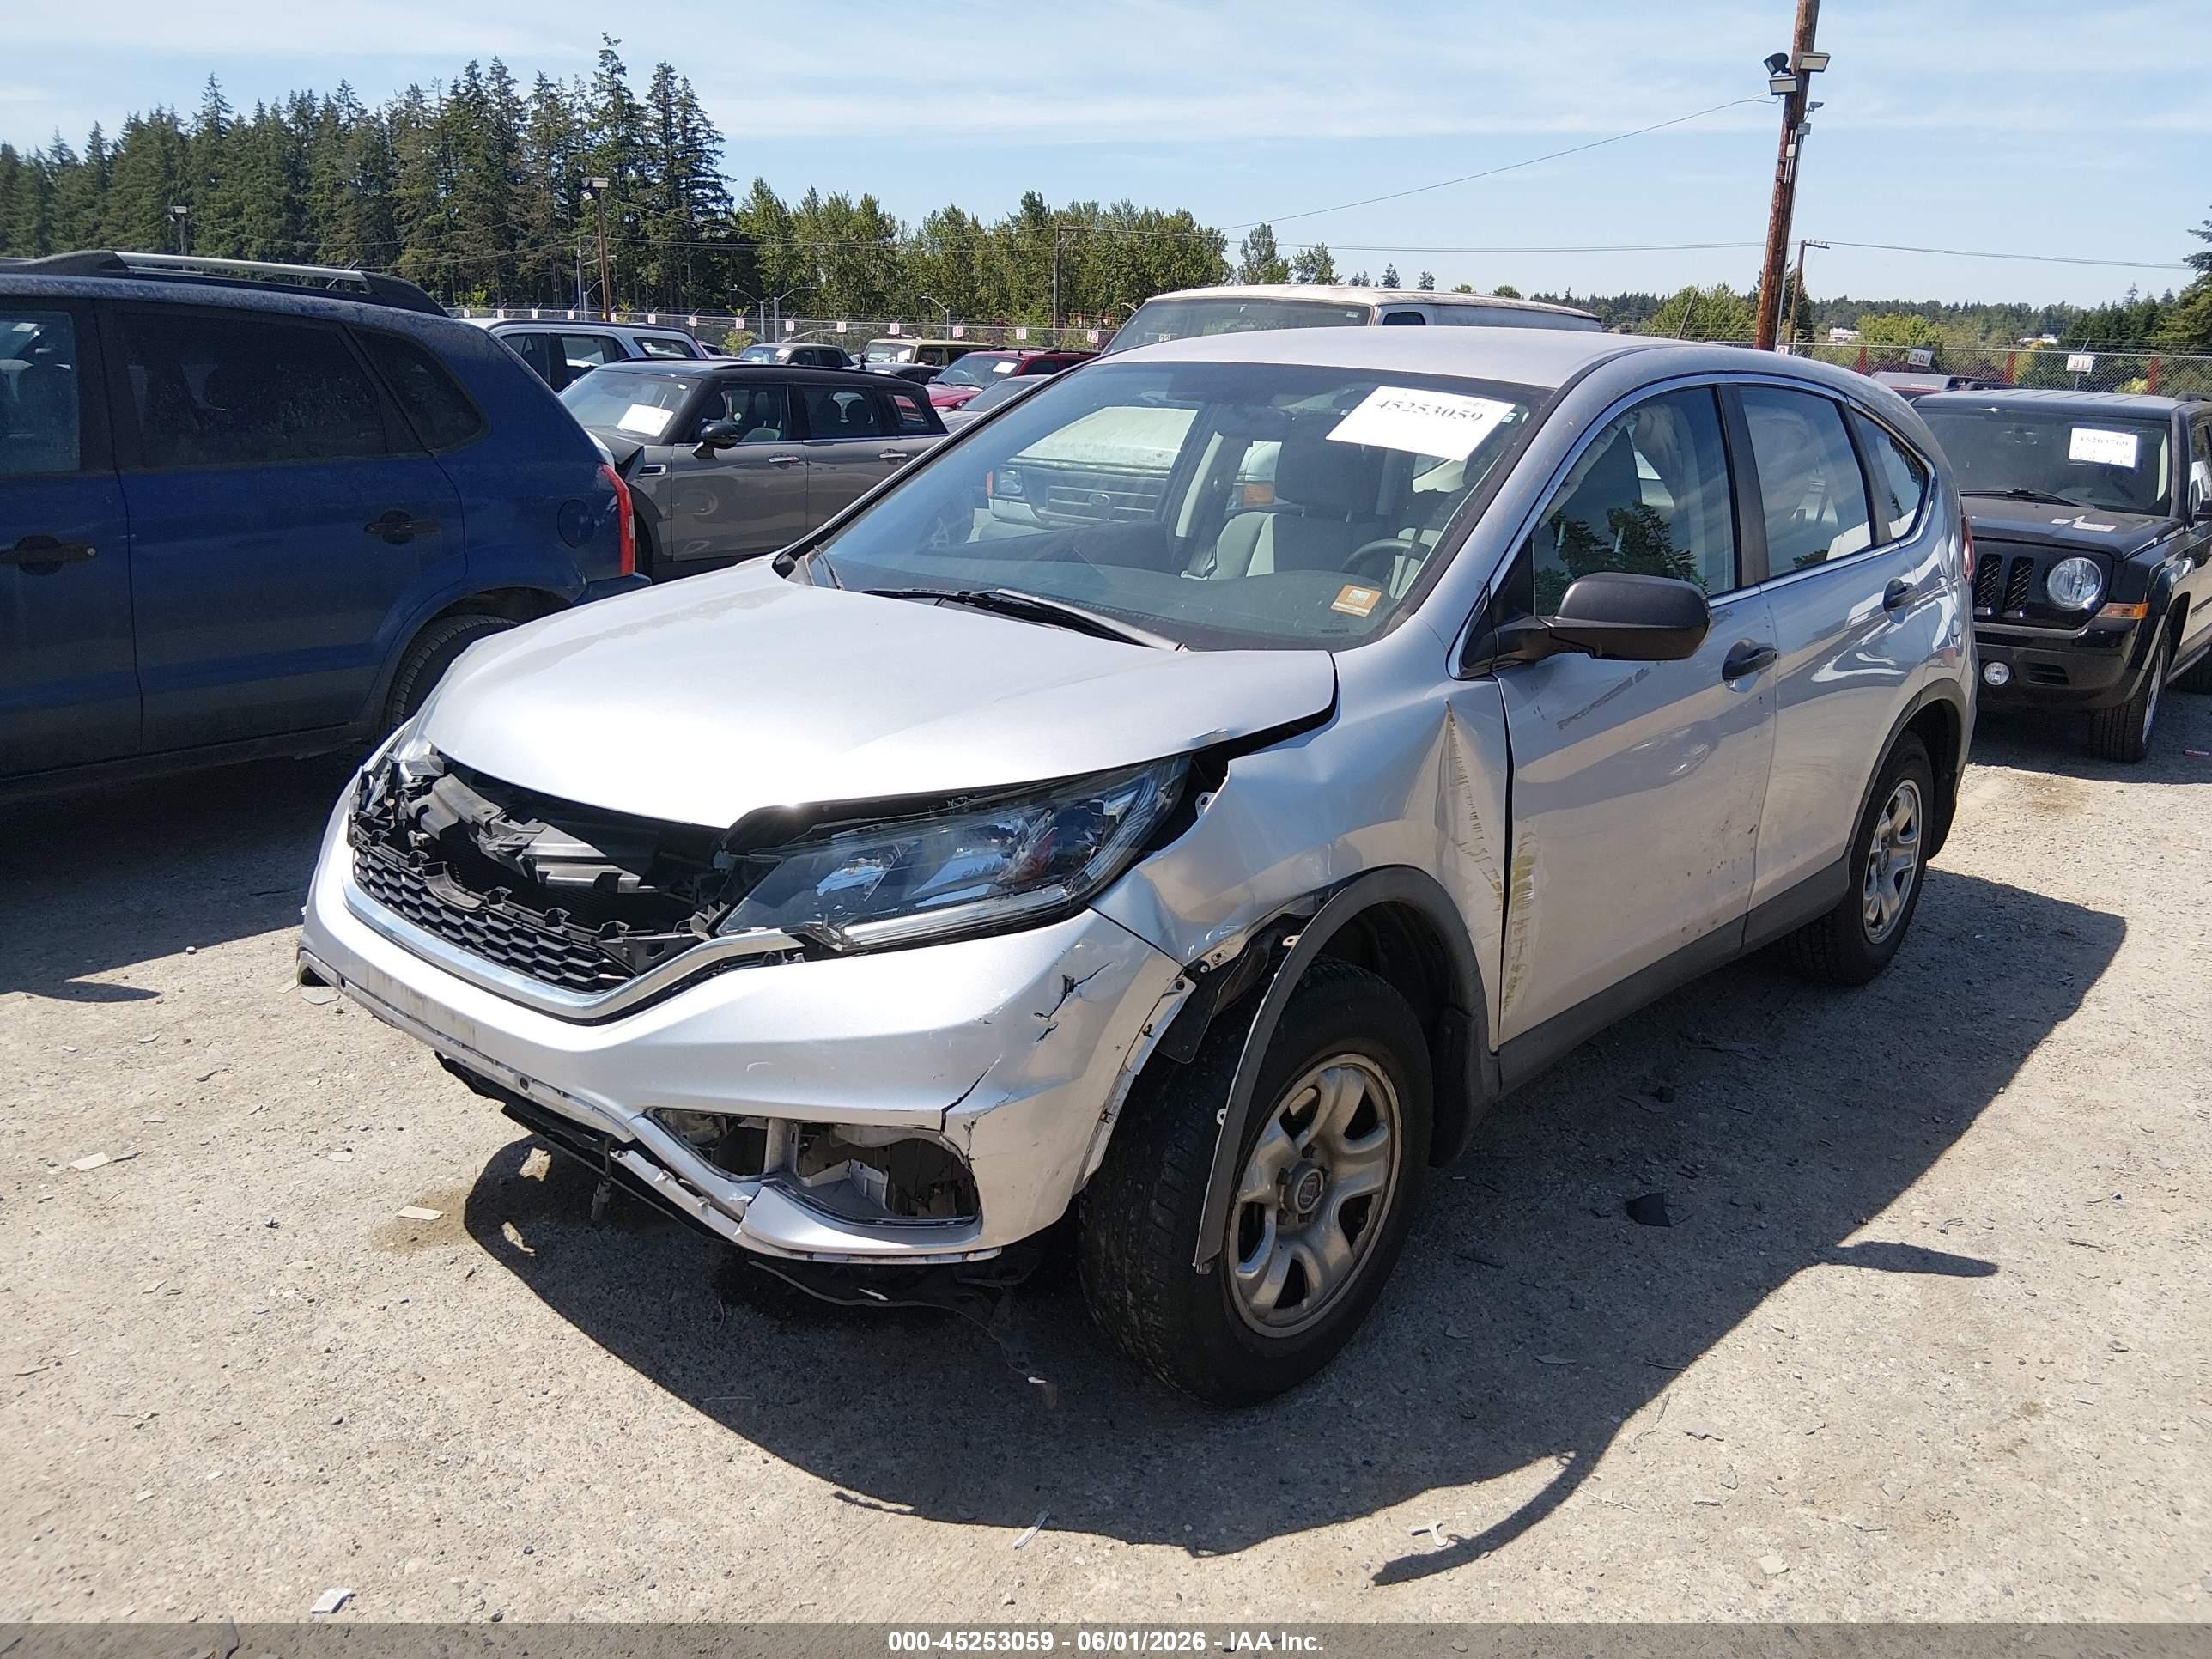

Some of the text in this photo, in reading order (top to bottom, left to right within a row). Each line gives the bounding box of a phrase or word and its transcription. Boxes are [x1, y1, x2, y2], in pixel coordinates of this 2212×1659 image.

[737, 319, 744, 328] 16
[891, 324, 898, 333] 19
[953, 327, 963, 337] 20
[1018, 329, 1025, 339] 21
[1088, 331, 1098, 342] 22
[1912, 353, 1925, 362] 30
[2073, 359, 2086, 368] 31
[1376, 399, 1484, 422] 45253059
